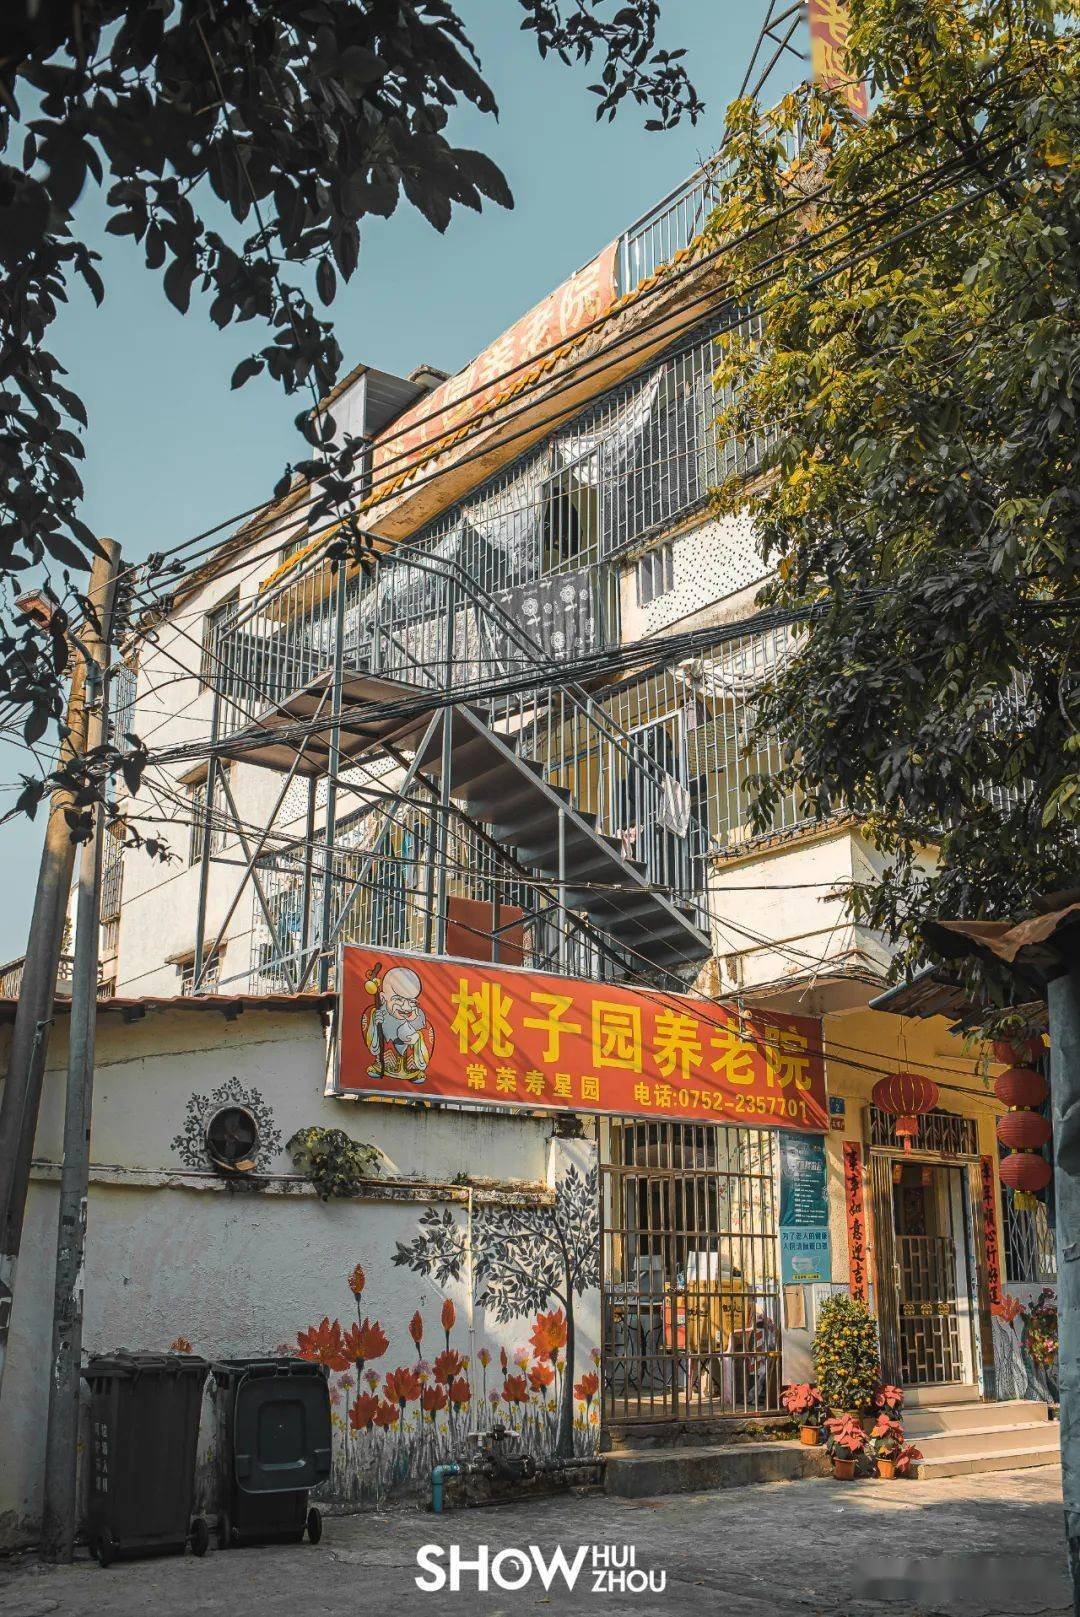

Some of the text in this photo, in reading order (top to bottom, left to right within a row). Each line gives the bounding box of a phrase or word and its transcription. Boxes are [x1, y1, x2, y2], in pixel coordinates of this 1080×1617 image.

[450, 978, 812, 1092] 桃子园养老院
[465, 1063, 601, 1102] 常荣寿星园
